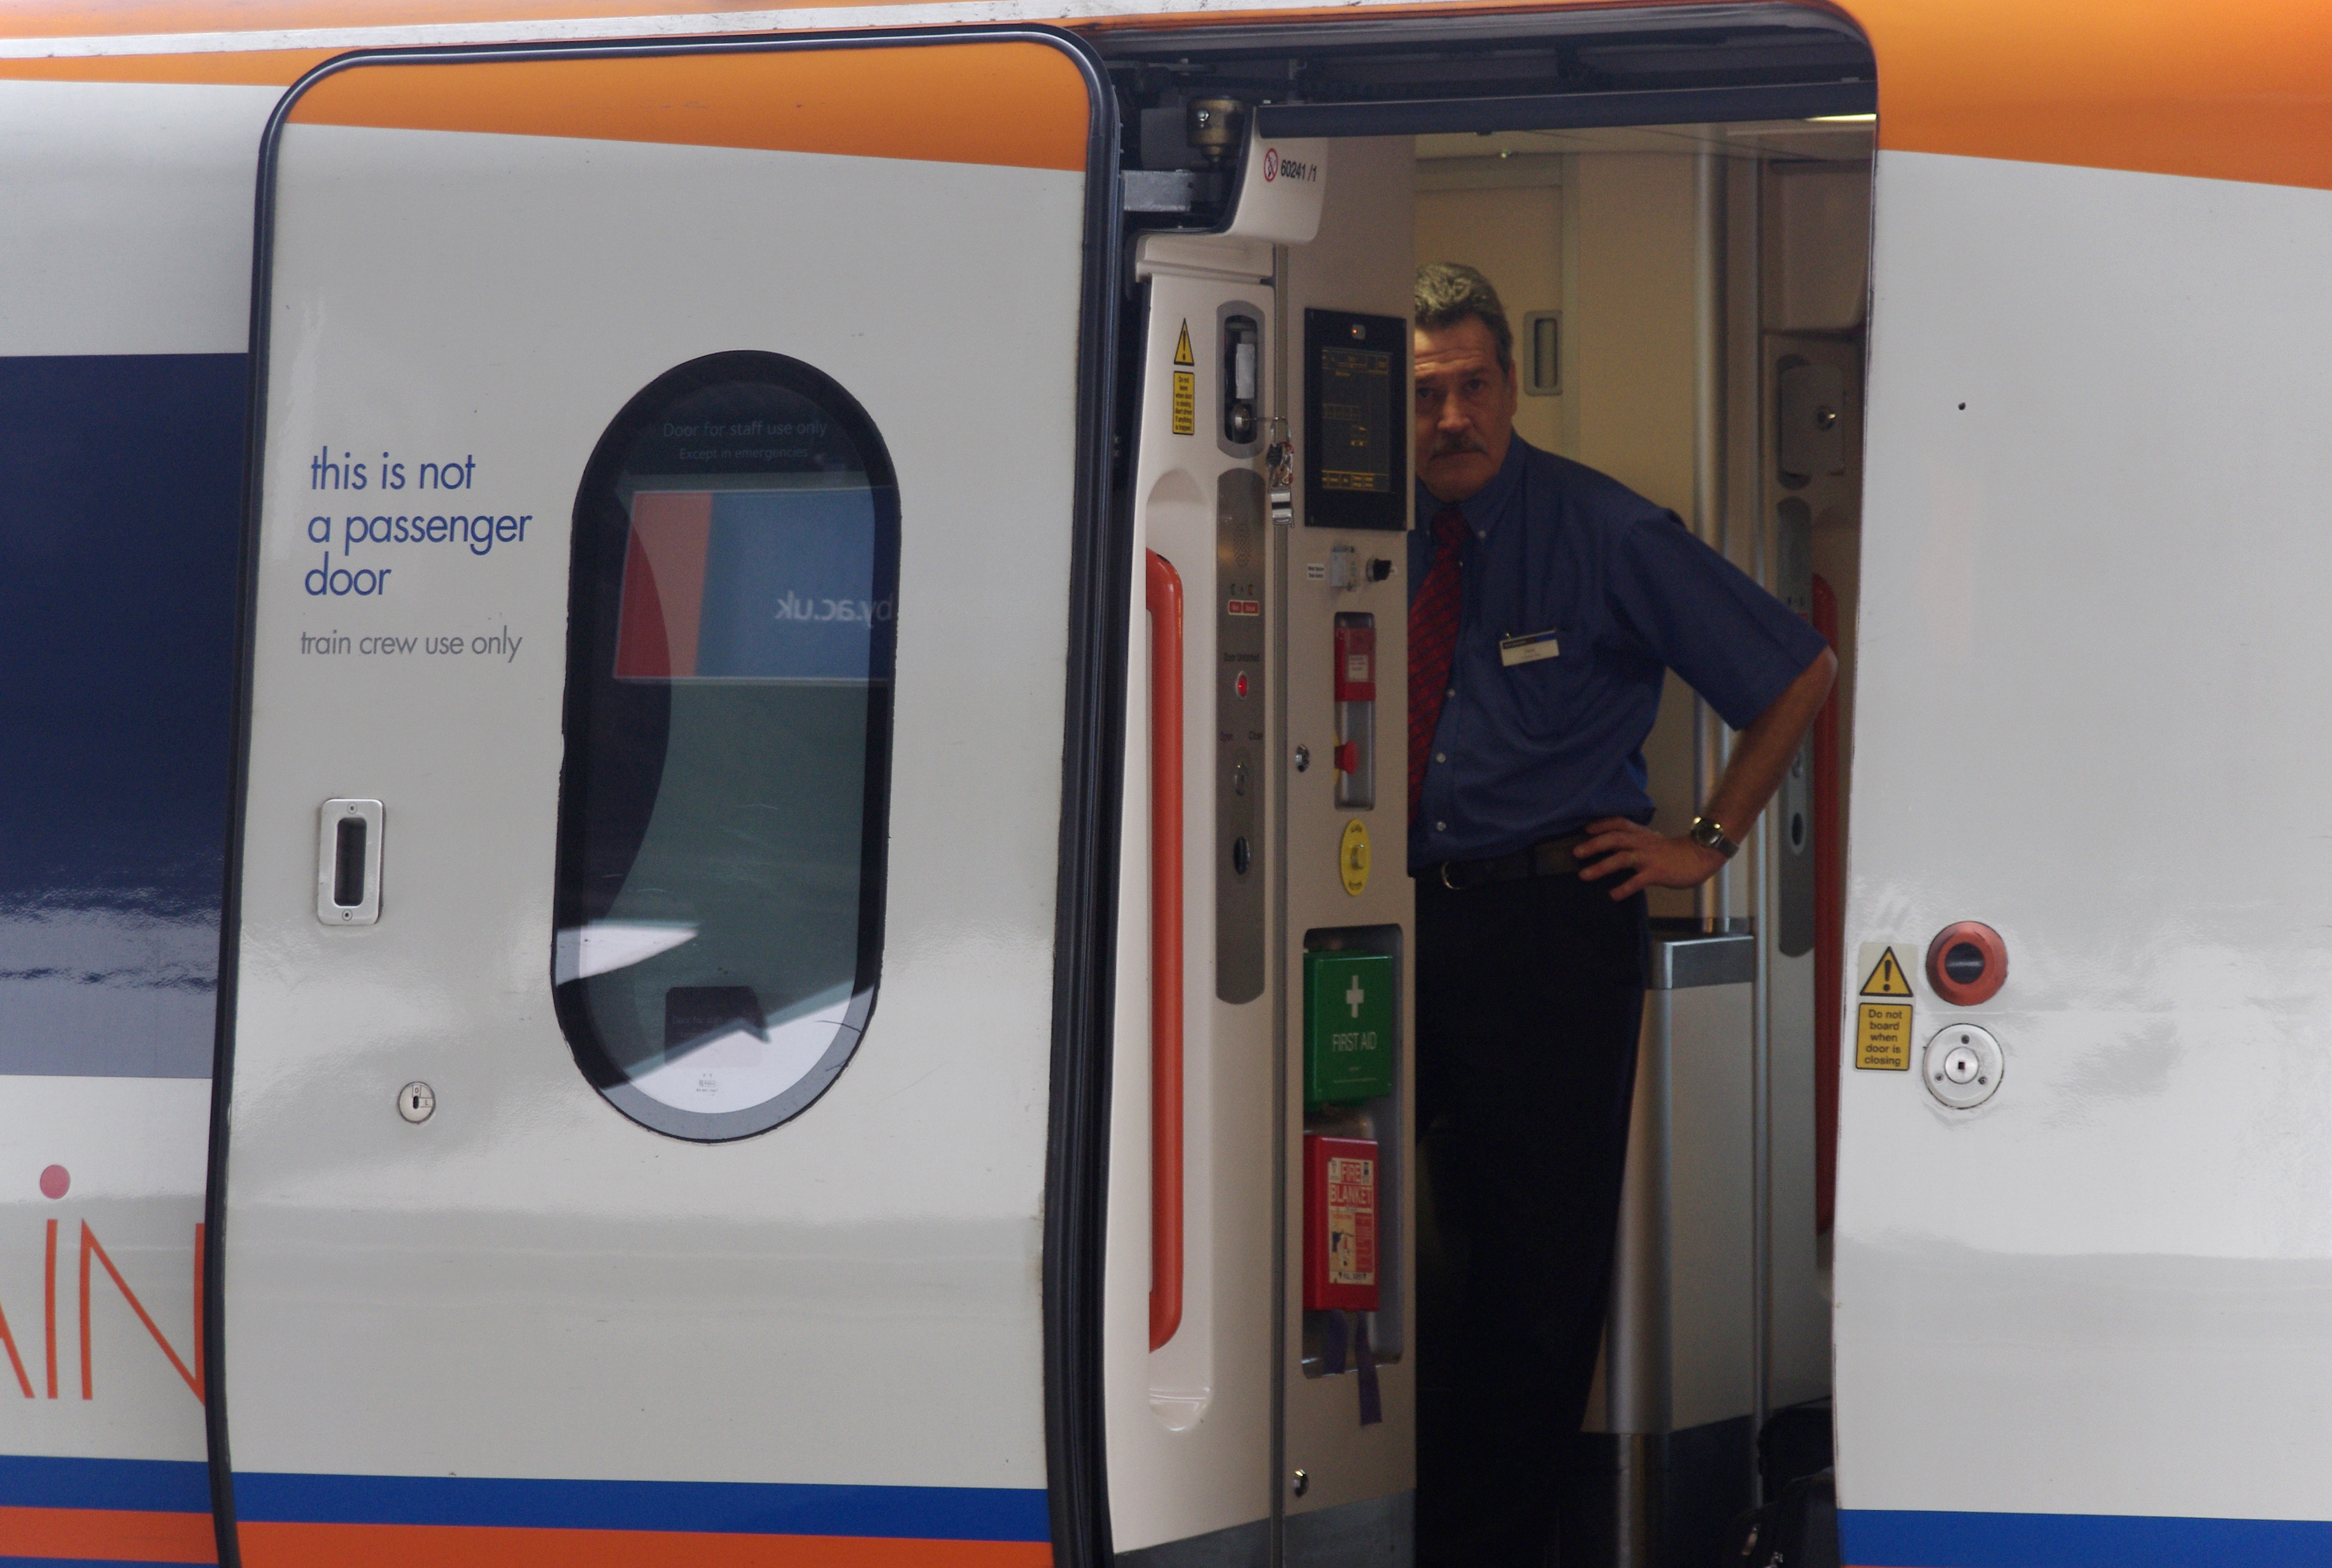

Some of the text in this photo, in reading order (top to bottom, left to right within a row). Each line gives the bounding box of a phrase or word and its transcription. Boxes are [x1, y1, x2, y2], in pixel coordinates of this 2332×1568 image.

[1281, 159, 1306, 180] 60241
[663, 420, 828, 438] Door for staff use only
[679, 446, 809, 461] Except in emergencies
[311, 446, 476, 490] this is not
[308, 515, 533, 556] a passenger
[305, 551, 392, 596] door
[300, 625, 523, 663] train crew use only
[1869, 1009, 1902, 1019] Do not
[1870, 1022, 1900, 1030] board
[1332, 1031, 1377, 1052] FIRST AID
[1870, 1033, 1898, 1042] when
[1866, 1043, 1902, 1054] door is
[1865, 1056, 1901, 1067] closing
[1341, 1163, 1360, 1181] FIRE
[1330, 1185, 1372, 1203] BLANKET
